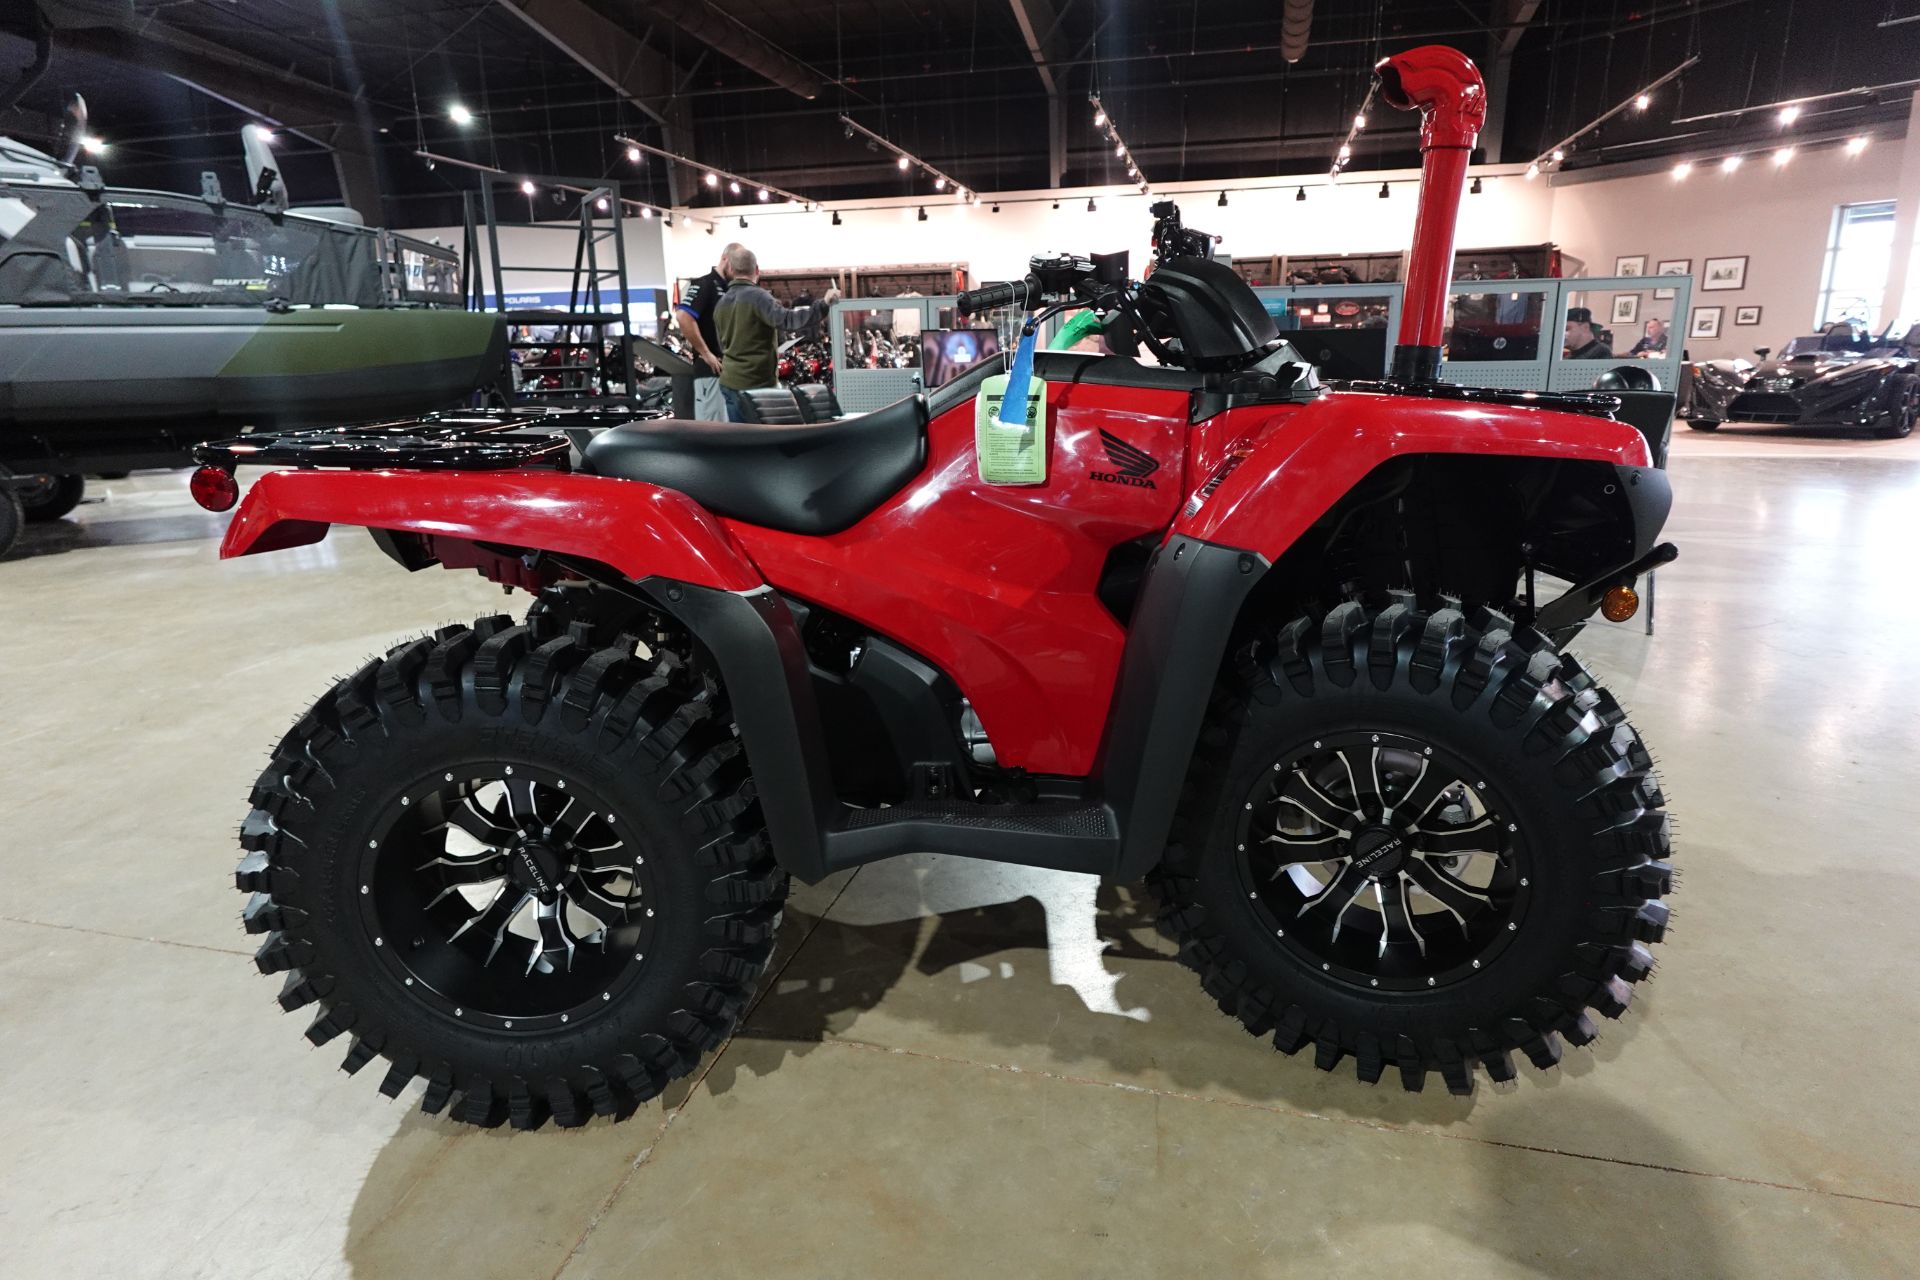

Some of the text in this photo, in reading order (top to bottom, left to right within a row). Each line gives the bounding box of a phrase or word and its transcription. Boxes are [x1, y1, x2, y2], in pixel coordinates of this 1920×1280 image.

[1089, 471, 1157, 490] HONDA
[1356, 838, 1402, 868] RACELINE
[518, 846, 550, 893] RACELINE
